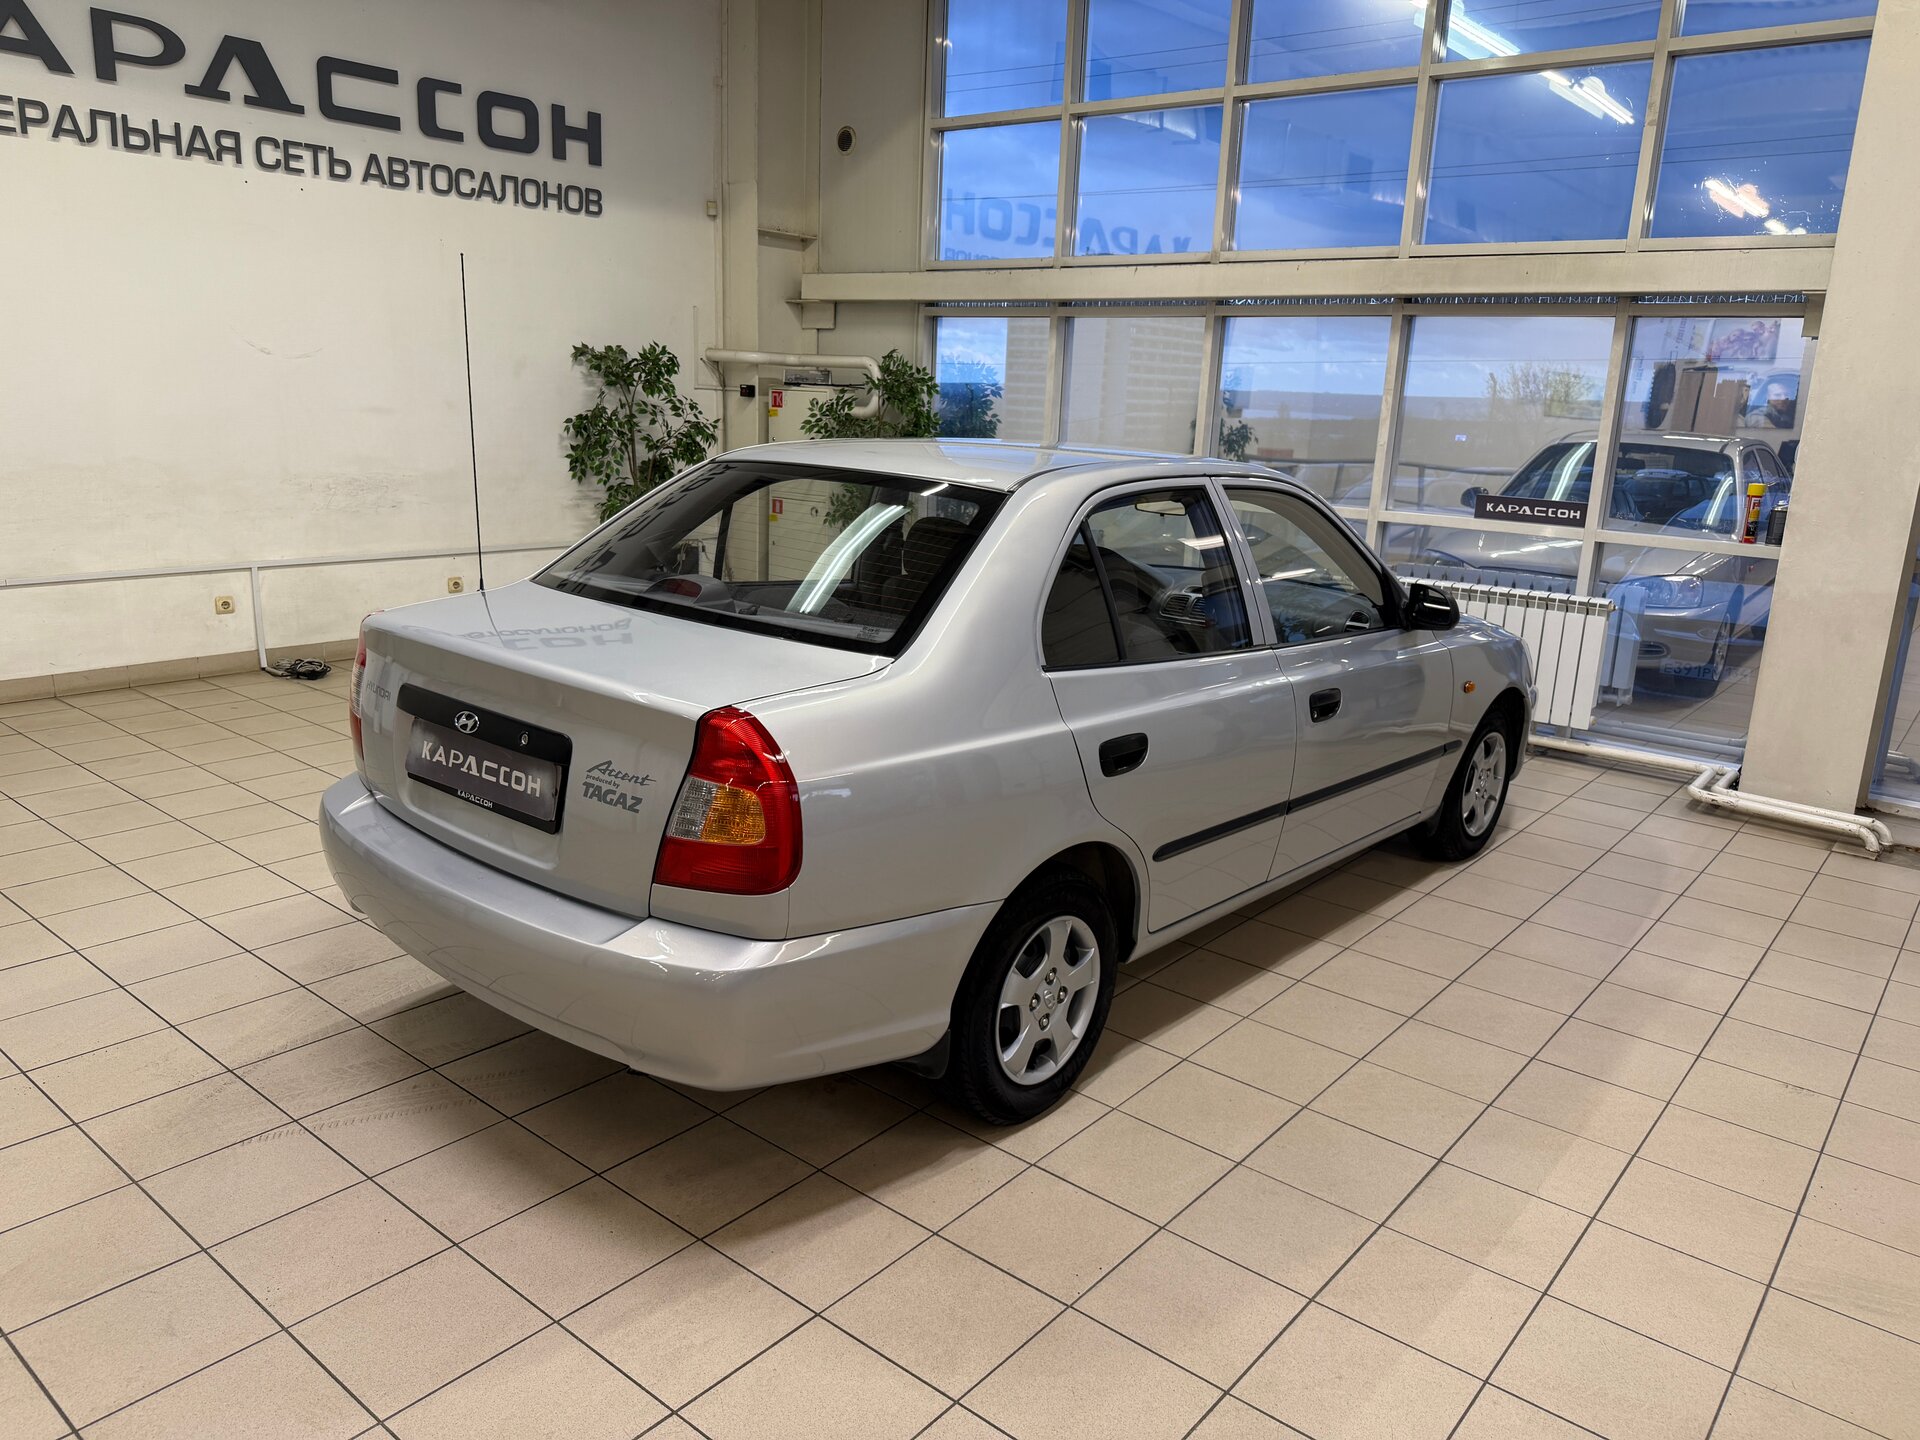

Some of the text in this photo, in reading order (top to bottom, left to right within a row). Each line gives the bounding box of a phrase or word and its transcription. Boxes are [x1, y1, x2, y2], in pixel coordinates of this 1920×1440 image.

[255, 136, 351, 180] СЕТЬ
[362, 153, 603, 216] АВТОСАЛОНОВ
[1486, 502, 1581, 519] КАРАССОН
[421, 740, 541, 798] КАРАССОН
[585, 774, 620, 789] produced by
[586, 760, 657, 786] Accent
[582, 781, 643, 814] TAGAZ
